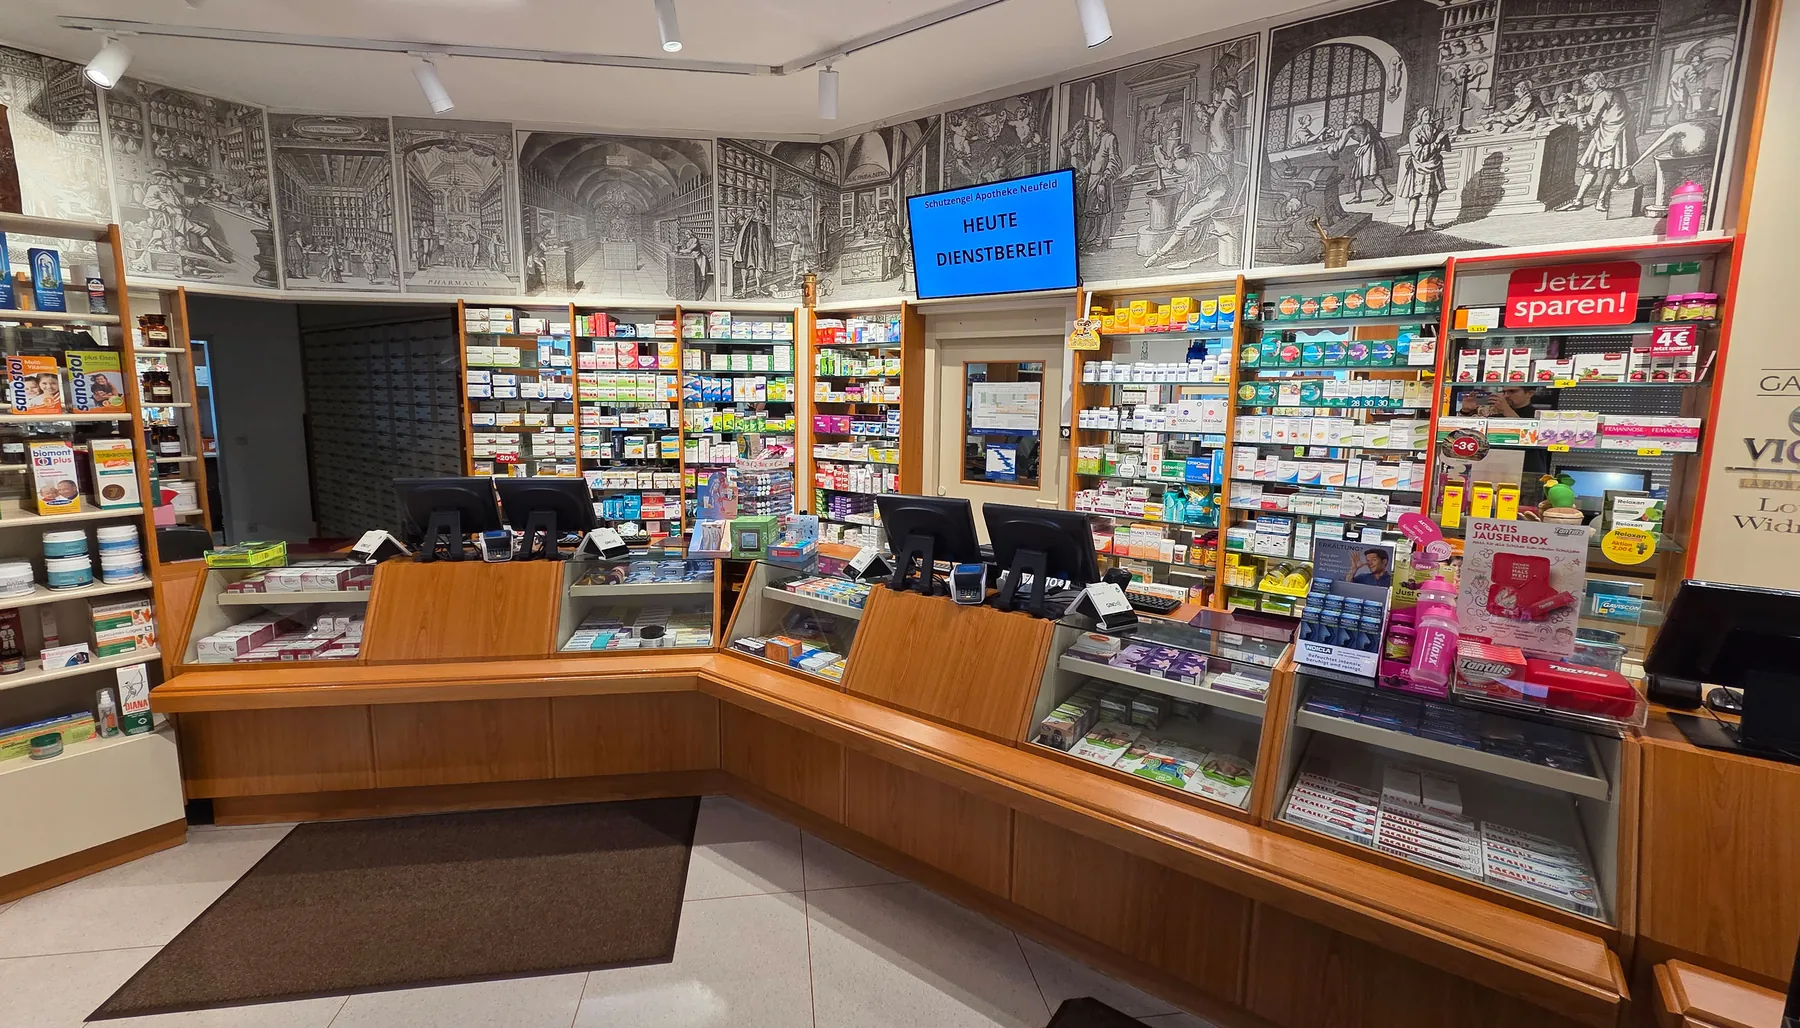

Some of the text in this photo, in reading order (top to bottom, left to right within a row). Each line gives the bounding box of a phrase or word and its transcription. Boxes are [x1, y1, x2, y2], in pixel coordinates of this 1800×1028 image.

[924, 179, 1058, 209] Schutzengel Apotheke Neufeld
[963, 212, 1018, 233] HEUTE
[1682, 205, 1694, 231] Stilaxx
[936, 239, 1054, 267] DIENSTBEREIT
[427, 279, 488, 287] PHARMACIA
[1534, 270, 1611, 293] Jetzt
[1514, 291, 1627, 323] sparen!
[1656, 331, 1690, 347] 4€
[8, 358, 28, 412] sanostol
[67, 354, 89, 412] sanostol
[1453, 441, 1476, 452] -3€
[32, 449, 71, 457] biomont
[497, 454, 517, 462] -20%
[53, 457, 72, 465] plus
[1473, 522, 1518, 533] GRATIS
[1472, 531, 1549, 546] JAUSENBOX
[1318, 541, 1364, 552] ERKÄLTUNG?
[1431, 546, 1447, 554] NEU
[1395, 589, 1415, 597] Just
[1603, 602, 1641, 611] GAVISCON
[1306, 644, 1331, 654] NOICLA
[1428, 631, 1446, 666] Stilaxx
[1305, 657, 1329, 667] beruhigt
[1308, 653, 1338, 662] Befeuchtet
[1460, 659, 1512, 676] Tantills
[124, 699, 149, 711] DIANA
